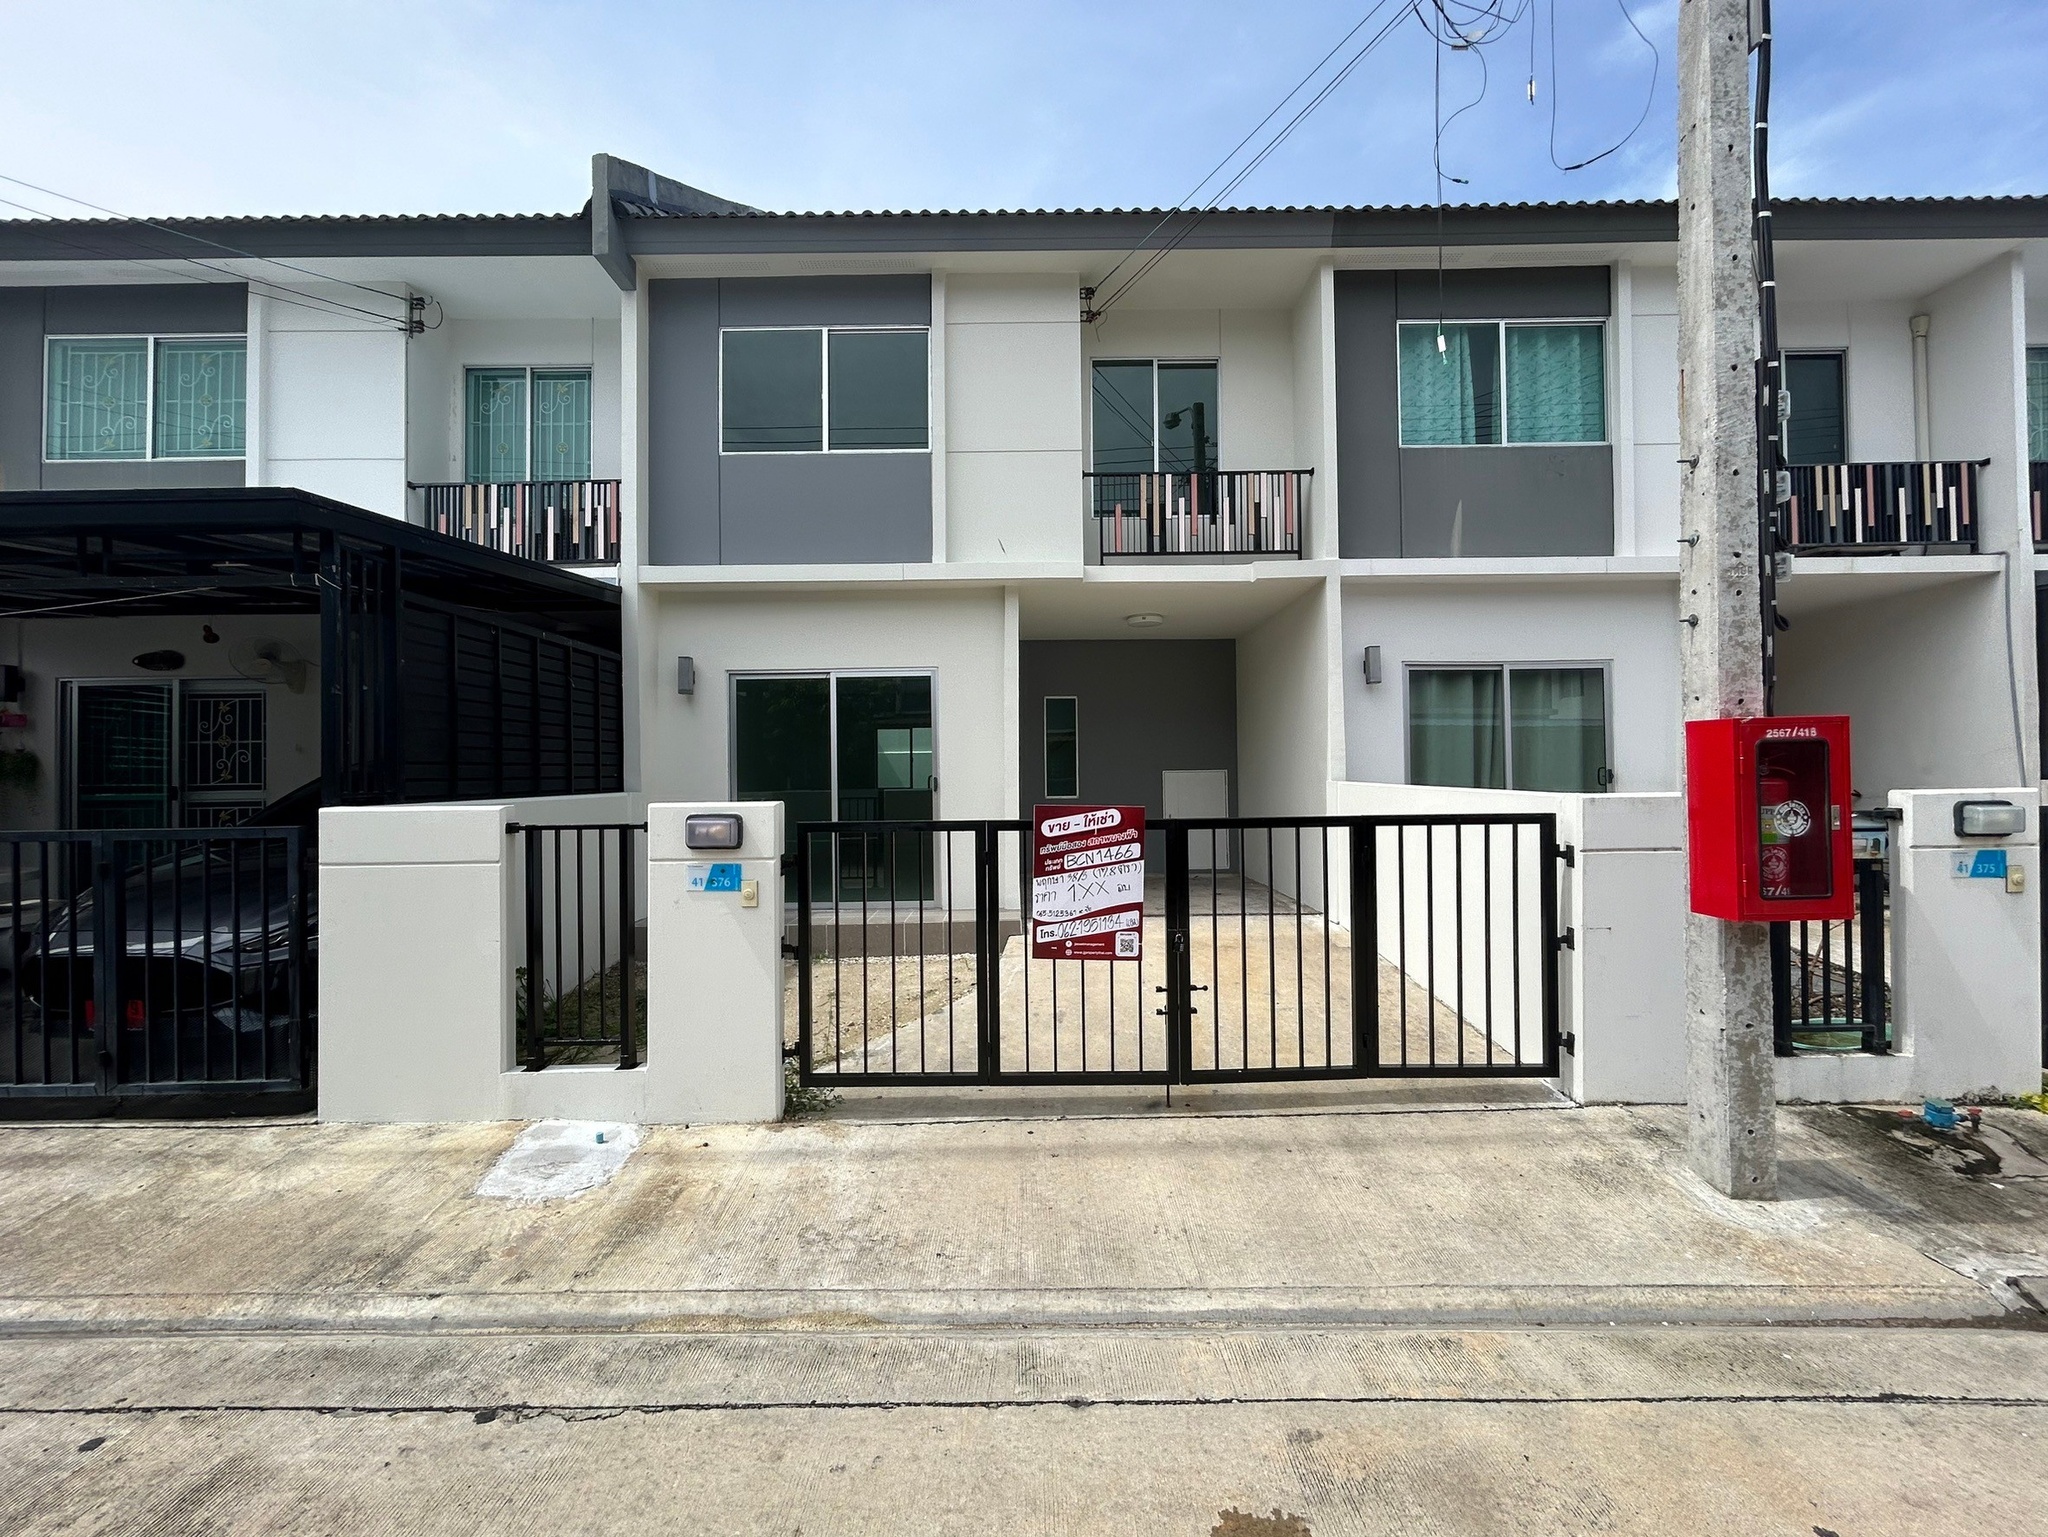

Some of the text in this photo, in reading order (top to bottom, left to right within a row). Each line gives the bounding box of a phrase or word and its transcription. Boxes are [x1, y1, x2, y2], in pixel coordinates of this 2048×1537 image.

[1047, 820, 1071, 834] ขาย
[1083, 811, 1115, 828] ให้เช่า
[1040, 839, 1087, 855] ทรัพย์มือสอง
[1957, 863, 1996, 874] 41 375
[691, 877, 731, 887] 41 376
[1035, 891, 1057, 903] ราคา
